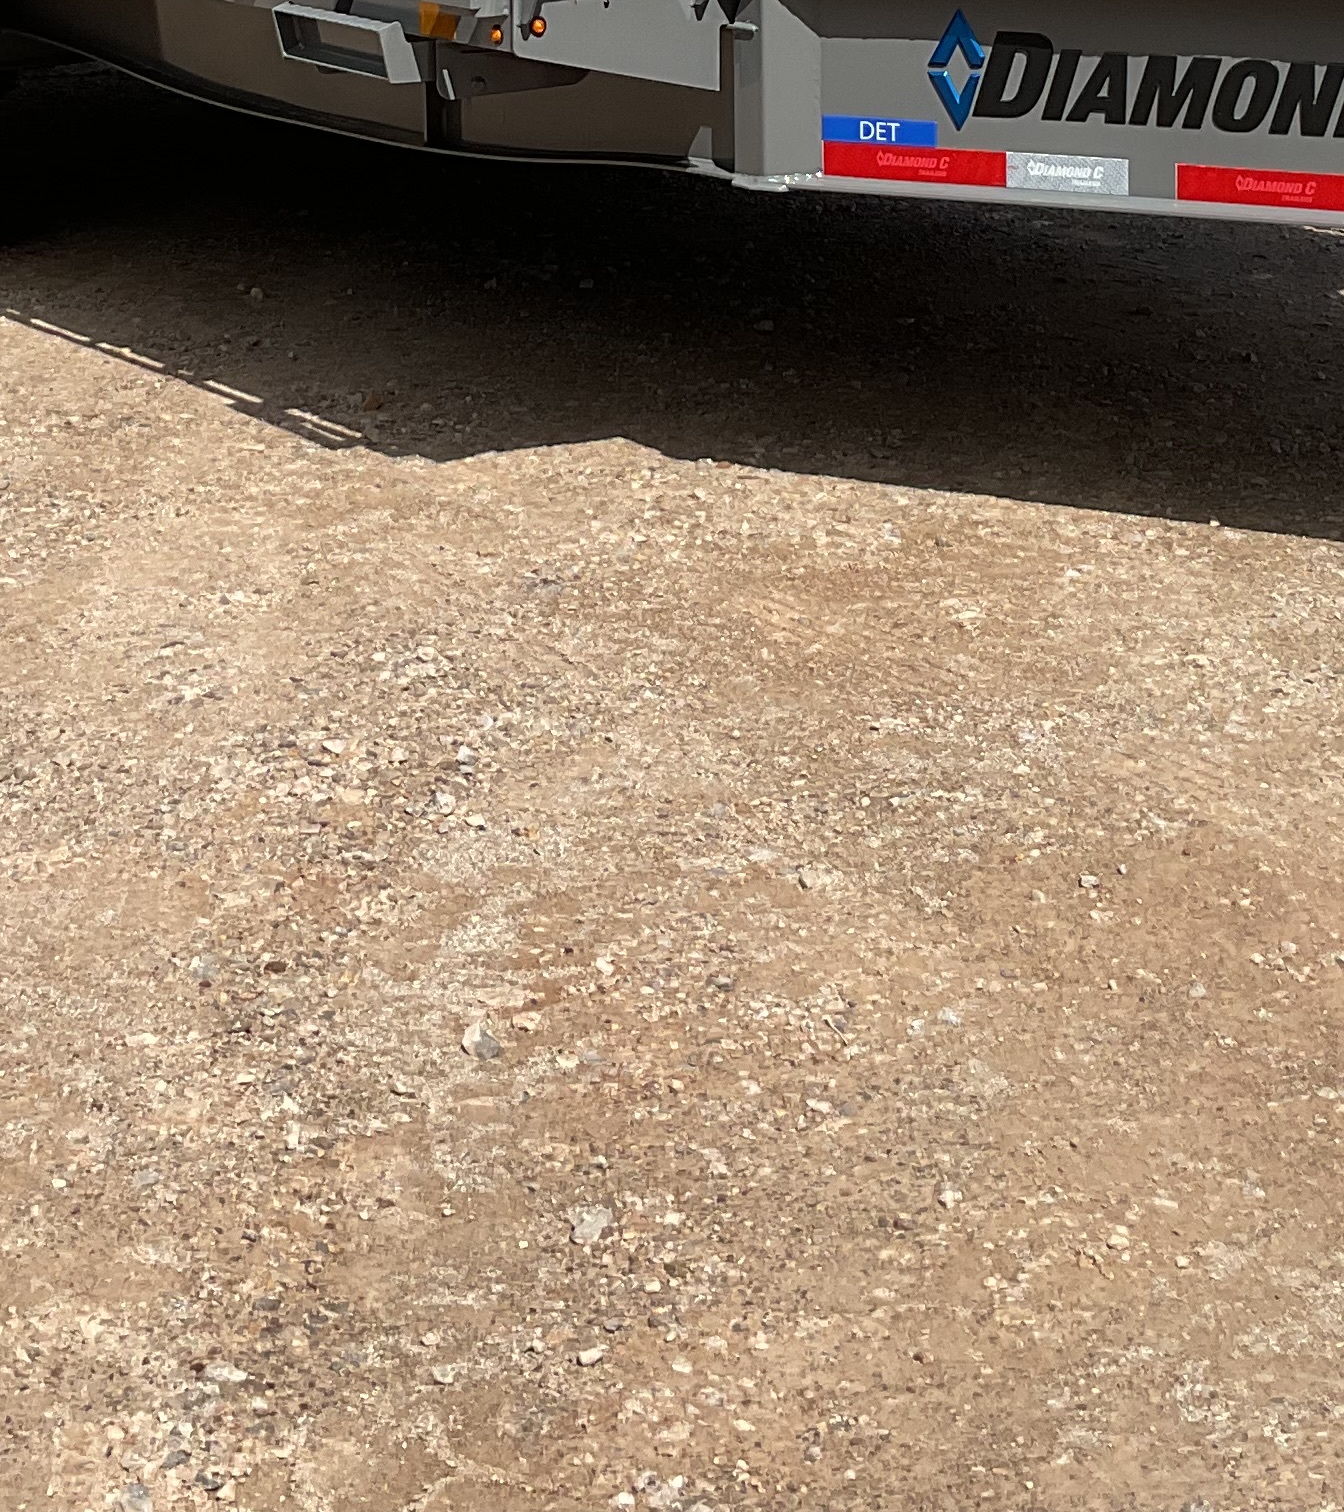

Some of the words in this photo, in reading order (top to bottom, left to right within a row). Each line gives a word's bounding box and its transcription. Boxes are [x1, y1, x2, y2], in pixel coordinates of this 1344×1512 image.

[859, 120, 901, 142] DET
[884, 152, 938, 169] DIAMOND
[939, 156, 950, 170] C
[1035, 161, 1093, 179] DIAMOND
[1093, 165, 1105, 179] C
[1243, 177, 1303, 194] DIAMOND
[1304, 181, 1317, 195] C
